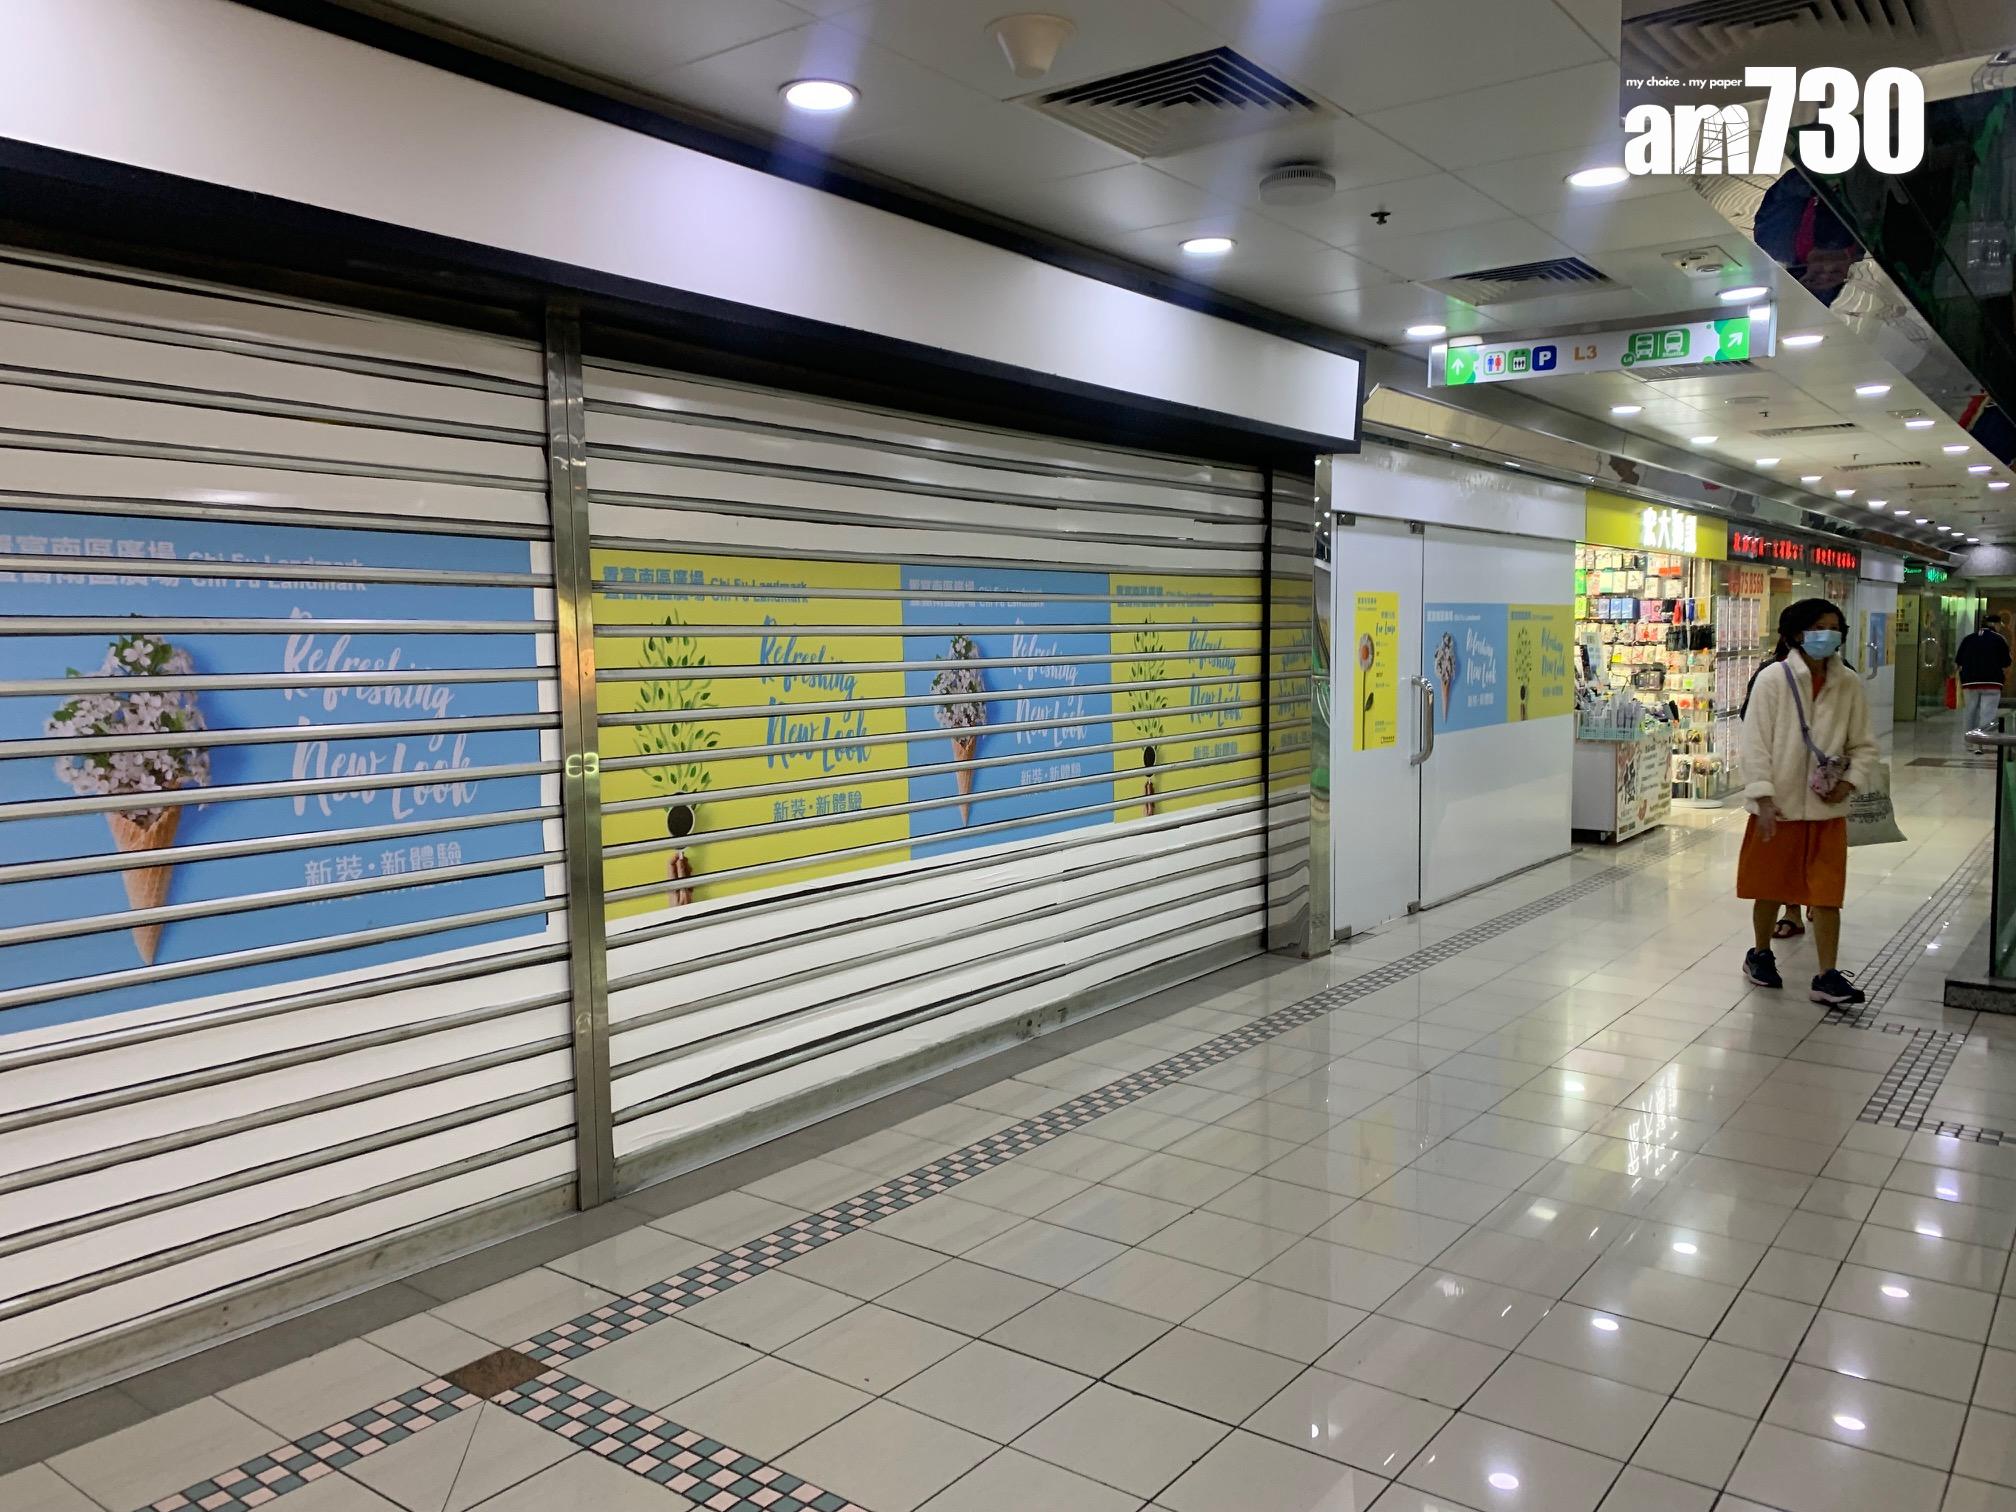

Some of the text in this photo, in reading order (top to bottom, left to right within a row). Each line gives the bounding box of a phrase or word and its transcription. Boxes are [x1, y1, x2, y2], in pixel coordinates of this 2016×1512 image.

[1574, 345, 1598, 361] L3
[284, 606, 456, 752] Refreshing
[759, 615, 858, 723] Refreshing
[766, 696, 872, 773] New Look
[1016, 684, 1087, 748] New Look
[292, 715, 478, 821] New Look
